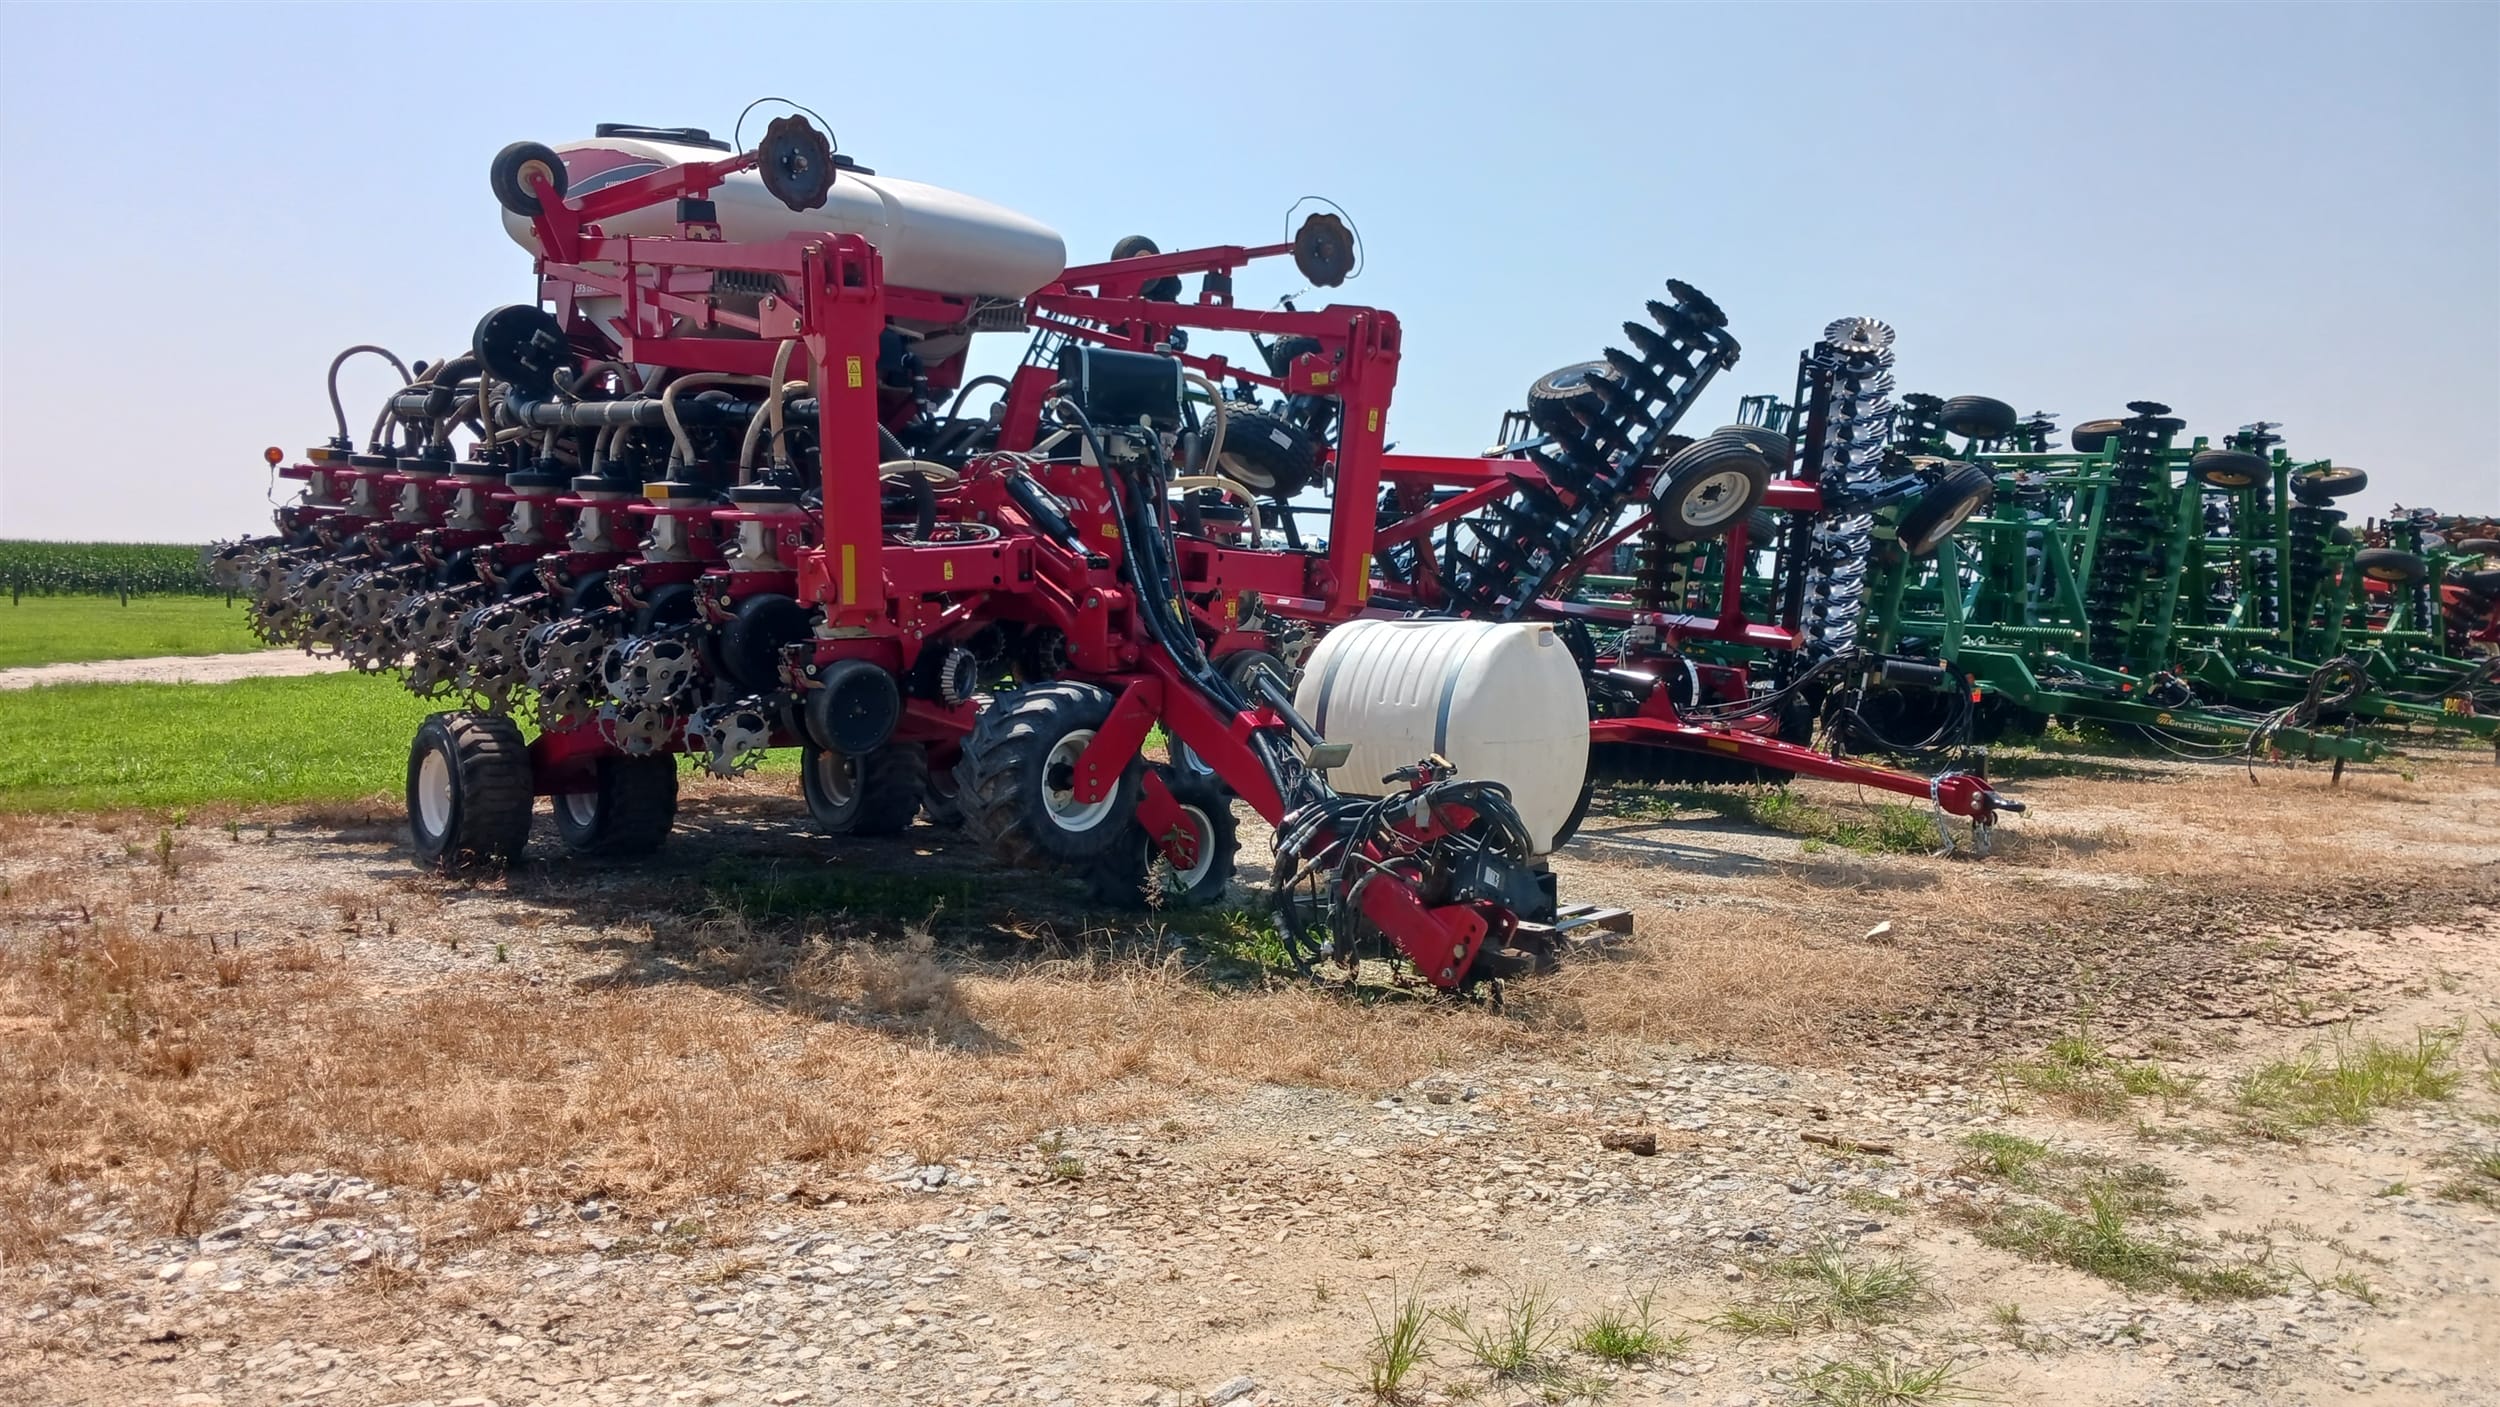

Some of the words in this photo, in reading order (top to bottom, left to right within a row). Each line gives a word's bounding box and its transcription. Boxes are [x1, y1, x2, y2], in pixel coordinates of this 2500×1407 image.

[2394, 709, 2415, 718] Great
[2415, 712, 2438, 722] Plains
[2169, 719, 2192, 729] Great
[2193, 723, 2218, 733] Plains
